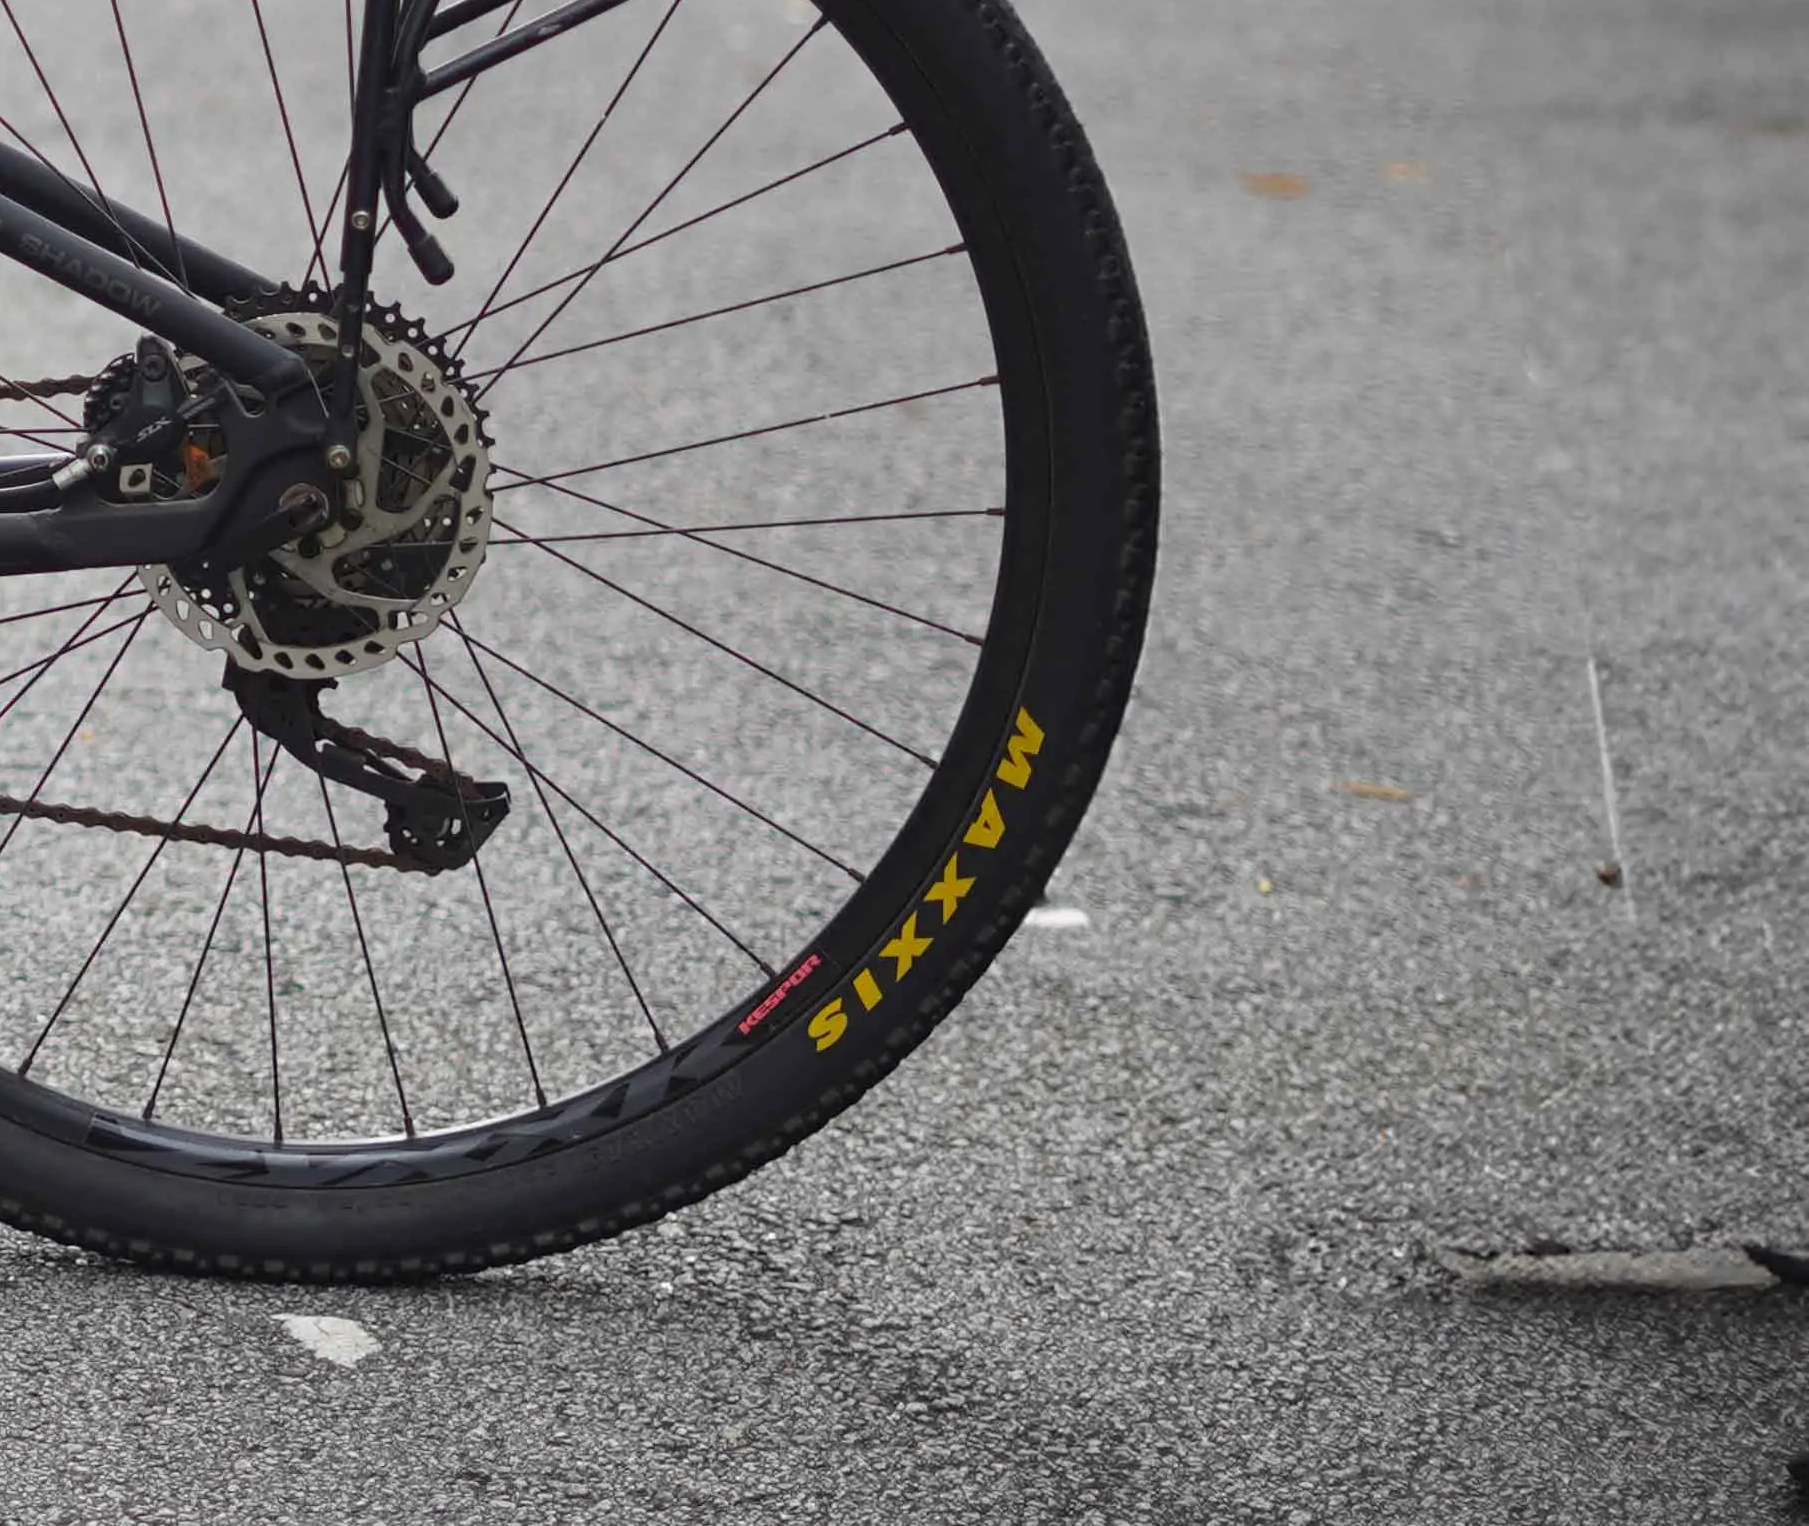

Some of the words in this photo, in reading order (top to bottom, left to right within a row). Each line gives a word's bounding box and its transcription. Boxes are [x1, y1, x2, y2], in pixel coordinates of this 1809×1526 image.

[18, 231, 163, 318] SHADOW
[136, 416, 172, 443] SLX
[807, 707, 1045, 1052] MAXXIS
[737, 953, 823, 1035] KESPOR
